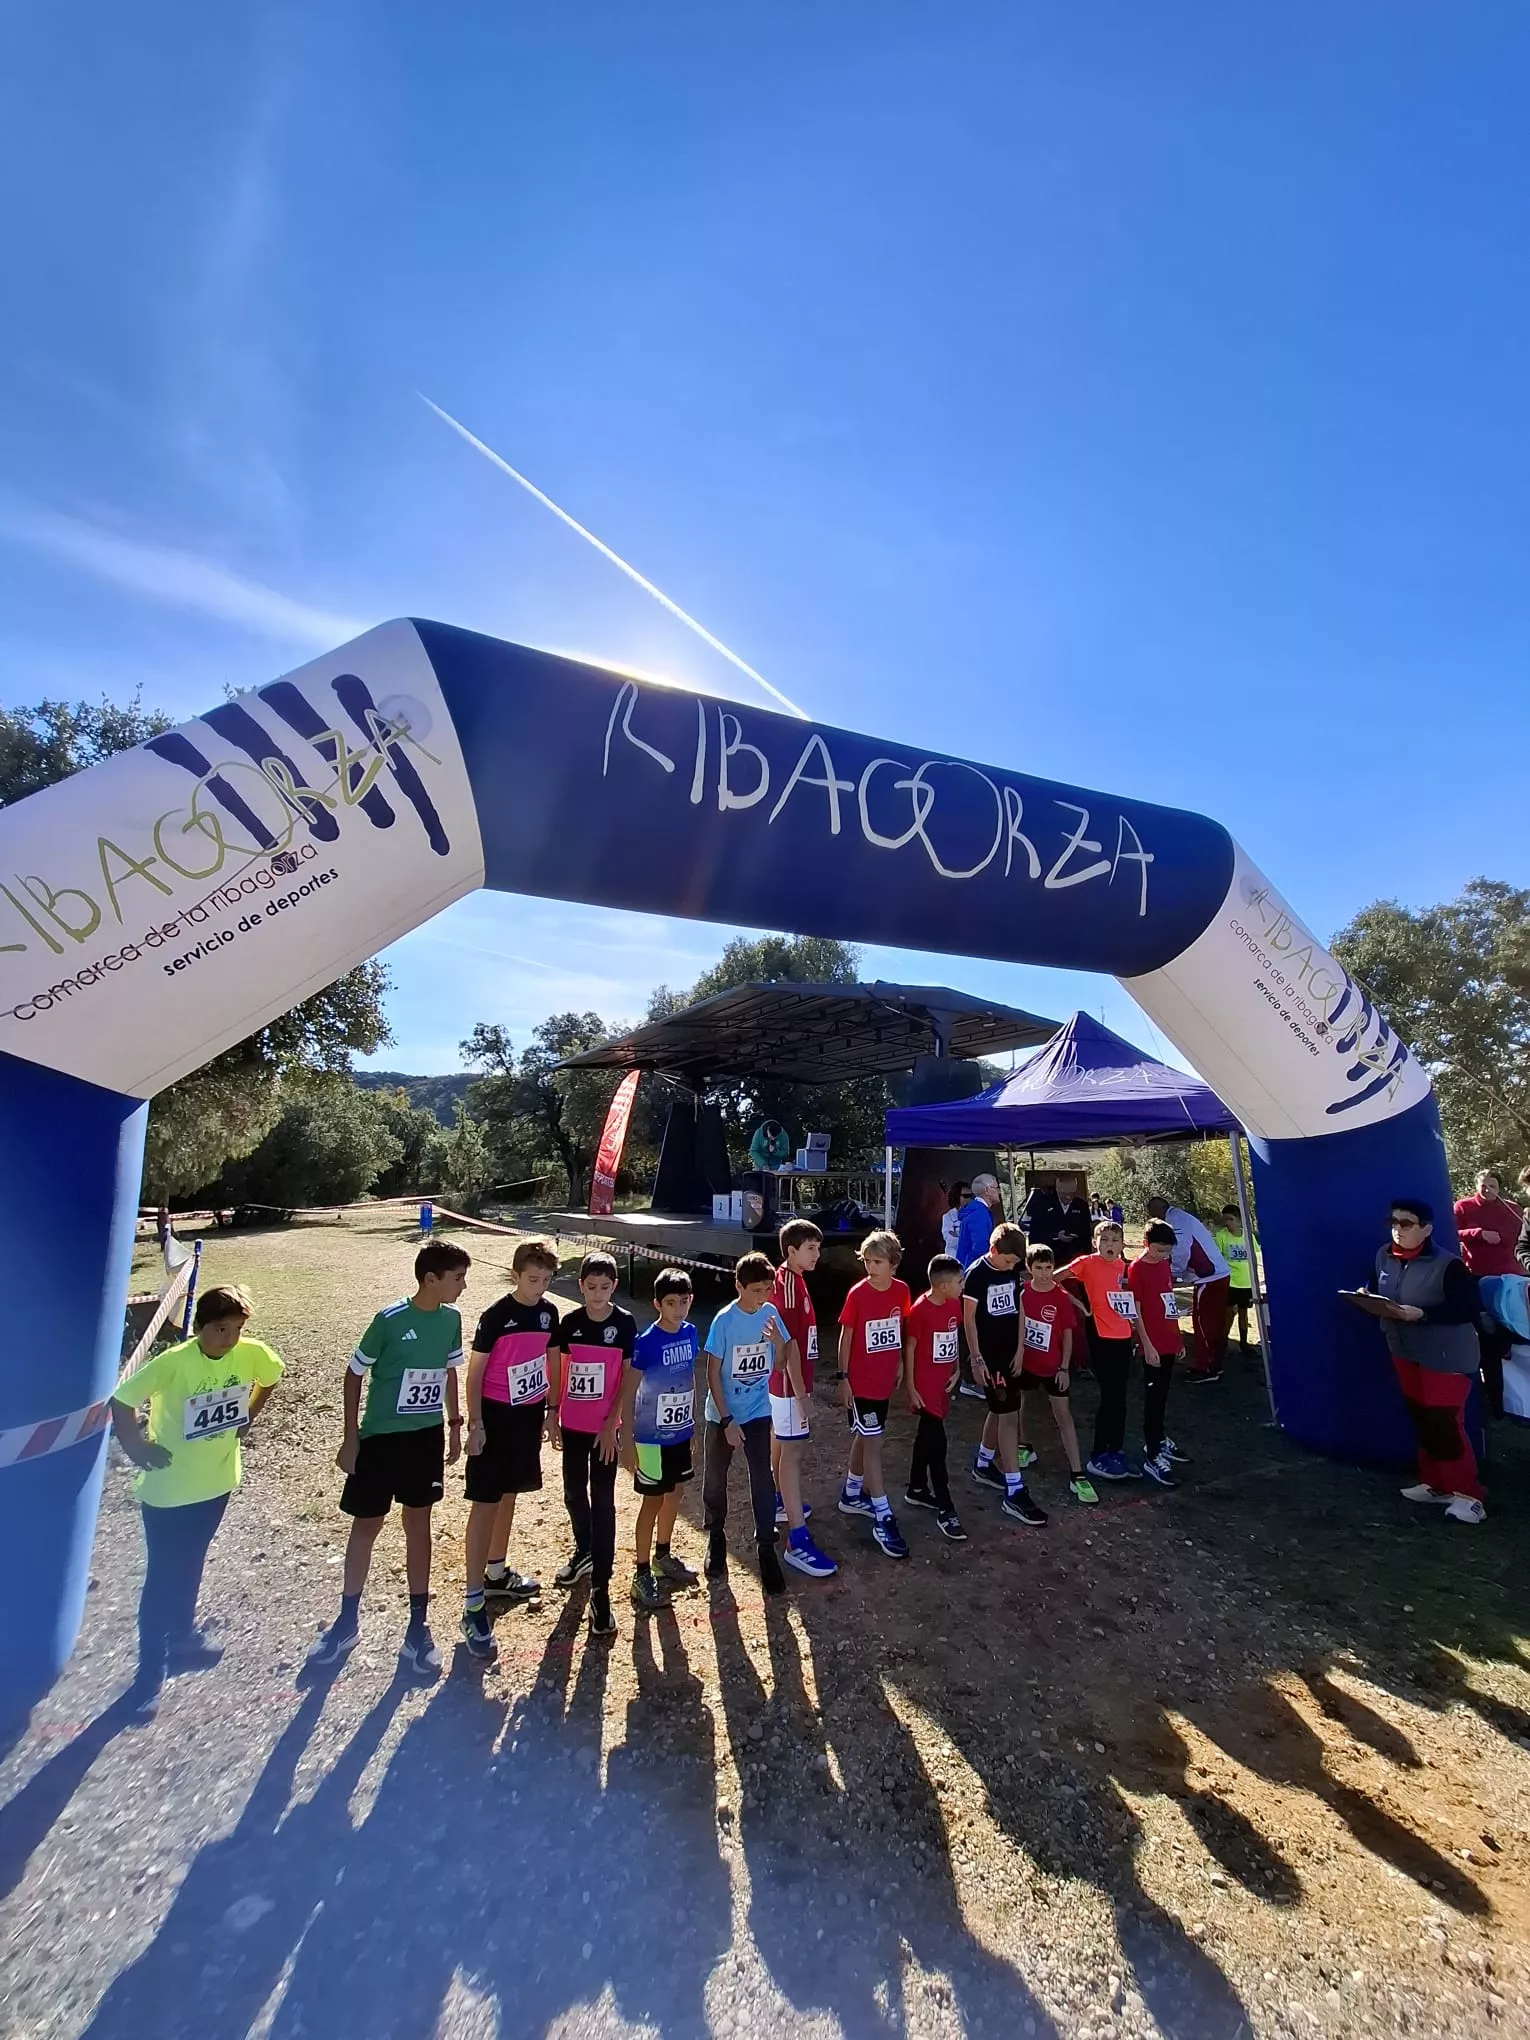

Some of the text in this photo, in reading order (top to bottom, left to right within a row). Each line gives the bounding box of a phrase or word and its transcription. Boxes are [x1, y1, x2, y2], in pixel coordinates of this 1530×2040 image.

[604, 680, 1155, 917] RIBAGORZA
[13, 842, 319, 1021] comarca de la ribagorza
[163, 867, 339, 976] servicio de deportes
[1229, 919, 1273, 970] comarca
[1270, 968, 1285, 985] de
[1282, 982, 1295, 998] la
[1253, 978, 1320, 1057] servicio de deportes
[718, 1202, 723, 1211] 2
[1232, 1249, 1248, 1258] 390
[991, 1294, 1011, 1310] 450
[871, 1329, 896, 1346] 365
[662, 1343, 693, 1366] GMMB
[738, 1355, 766, 1373] 440
[516, 1369, 543, 1396] 340
[570, 1376, 595, 1393] 341
[406, 1384, 441, 1405] 339
[194, 1400, 240, 1429] 445
[662, 1404, 690, 1424] 368
